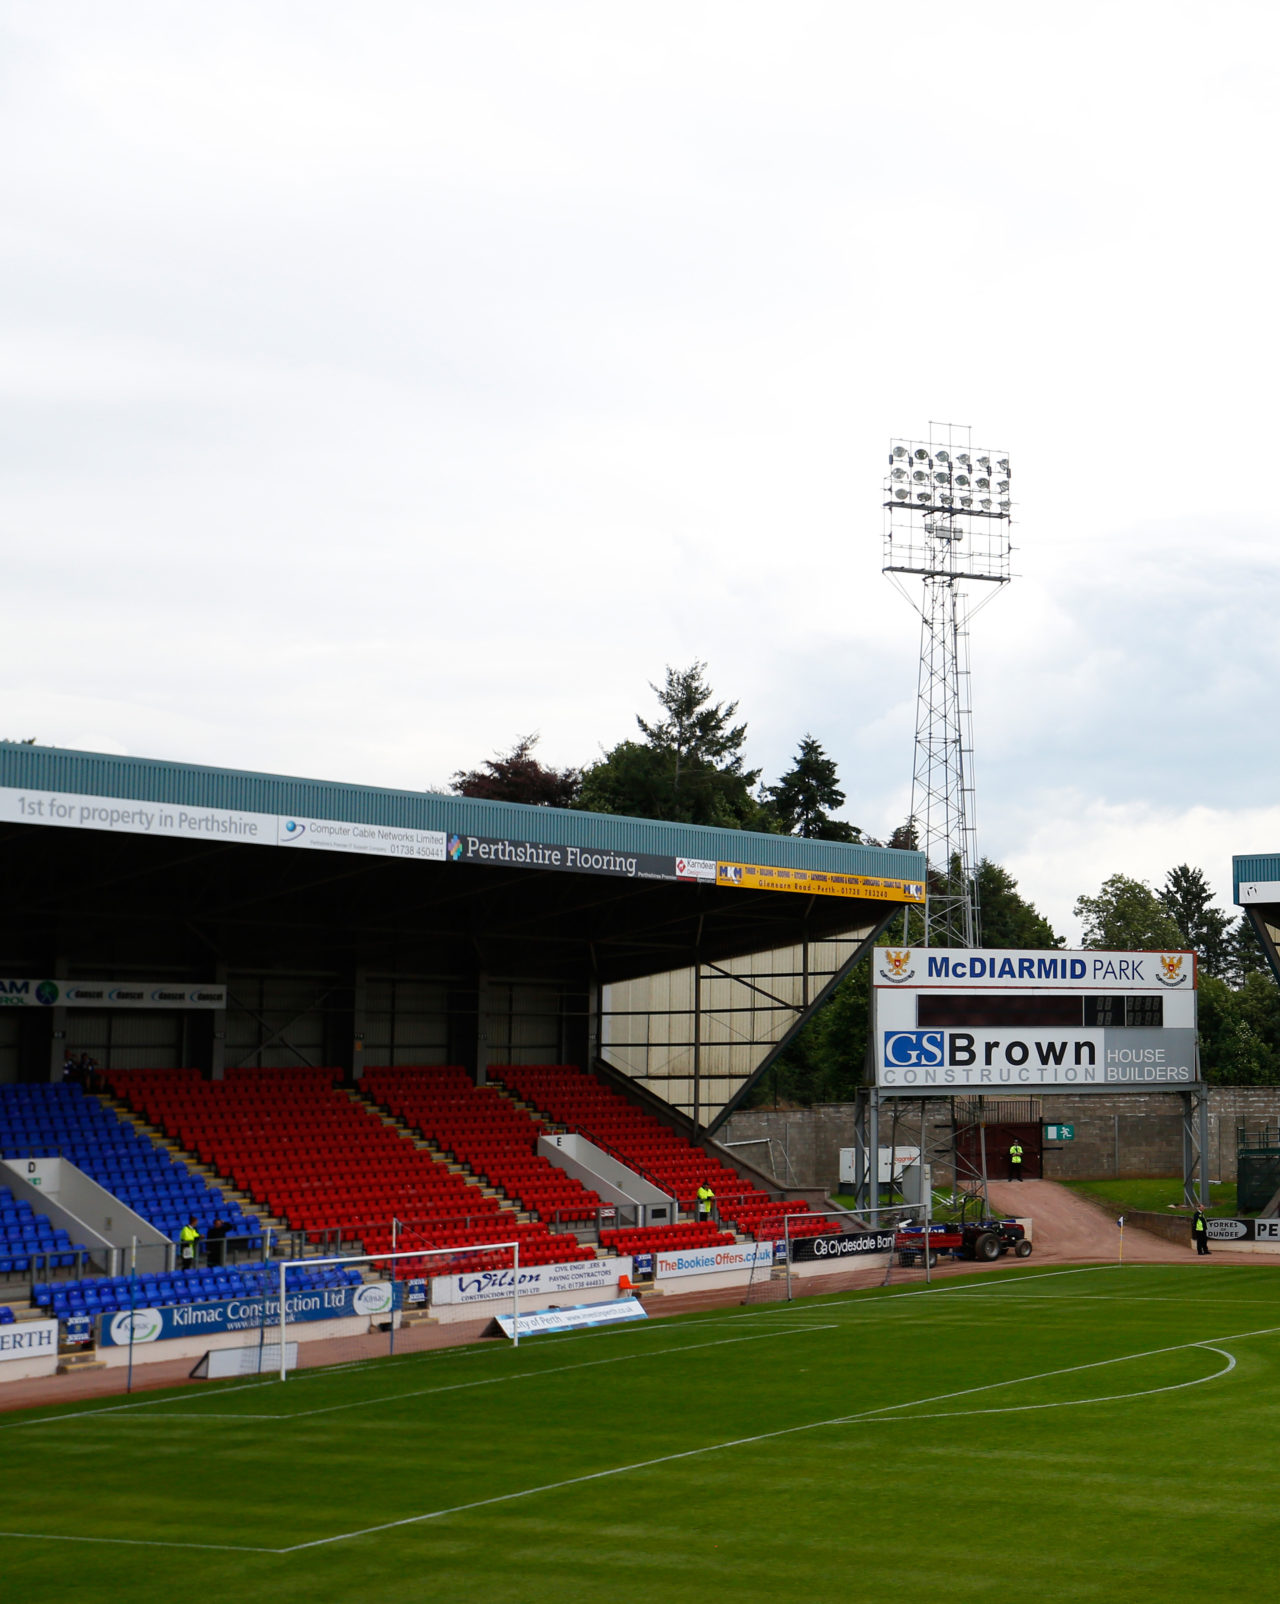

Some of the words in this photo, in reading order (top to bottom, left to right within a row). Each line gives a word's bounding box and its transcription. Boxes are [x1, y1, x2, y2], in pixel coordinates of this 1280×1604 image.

[18, 797, 44, 816] 1st
[49, 798, 75, 819] for
[80, 807, 155, 830] property
[159, 810, 174, 827] in
[178, 812, 257, 836] Perthshire
[309, 822, 350, 838] Computer
[352, 825, 376, 839] Cable
[378, 830, 414, 843] Networks
[416, 833, 444, 845] Limited
[390, 844, 414, 855] 01738
[466, 837, 561, 866] Perthshire
[566, 847, 637, 877] Flooring
[719, 865, 742, 883] MKM
[903, 884, 922, 900] MKM
[927, 957, 1086, 980] McDIARMID
[1093, 959, 1145, 981] PARK
[885, 1033, 943, 1066] GS
[949, 1033, 1096, 1067] Brown
[1107, 1049, 1165, 1063] HOUSE
[883, 1068, 1096, 1085] CONSTRUCTION
[1107, 1067, 1189, 1081] BUILDERS
[556, 1137, 562, 1146] E
[28, 1162, 36, 1173] D
[828, 1238, 876, 1255] Clydesdale
[659, 1250, 771, 1273] TheBookiesOffers.co.uk
[458, 1271, 541, 1292] Wilson
[571, 1269, 612, 1280] CONTRACTORS
[461, 1292, 505, 1301] CONSTRUCTION
[506, 1289, 529, 1298] (PETH)
[173, 1306, 223, 1326] Kilmac
[325, 1290, 345, 1308] Ltd
[532, 1316, 540, 1327] of
[541, 1315, 562, 1325] Perth
